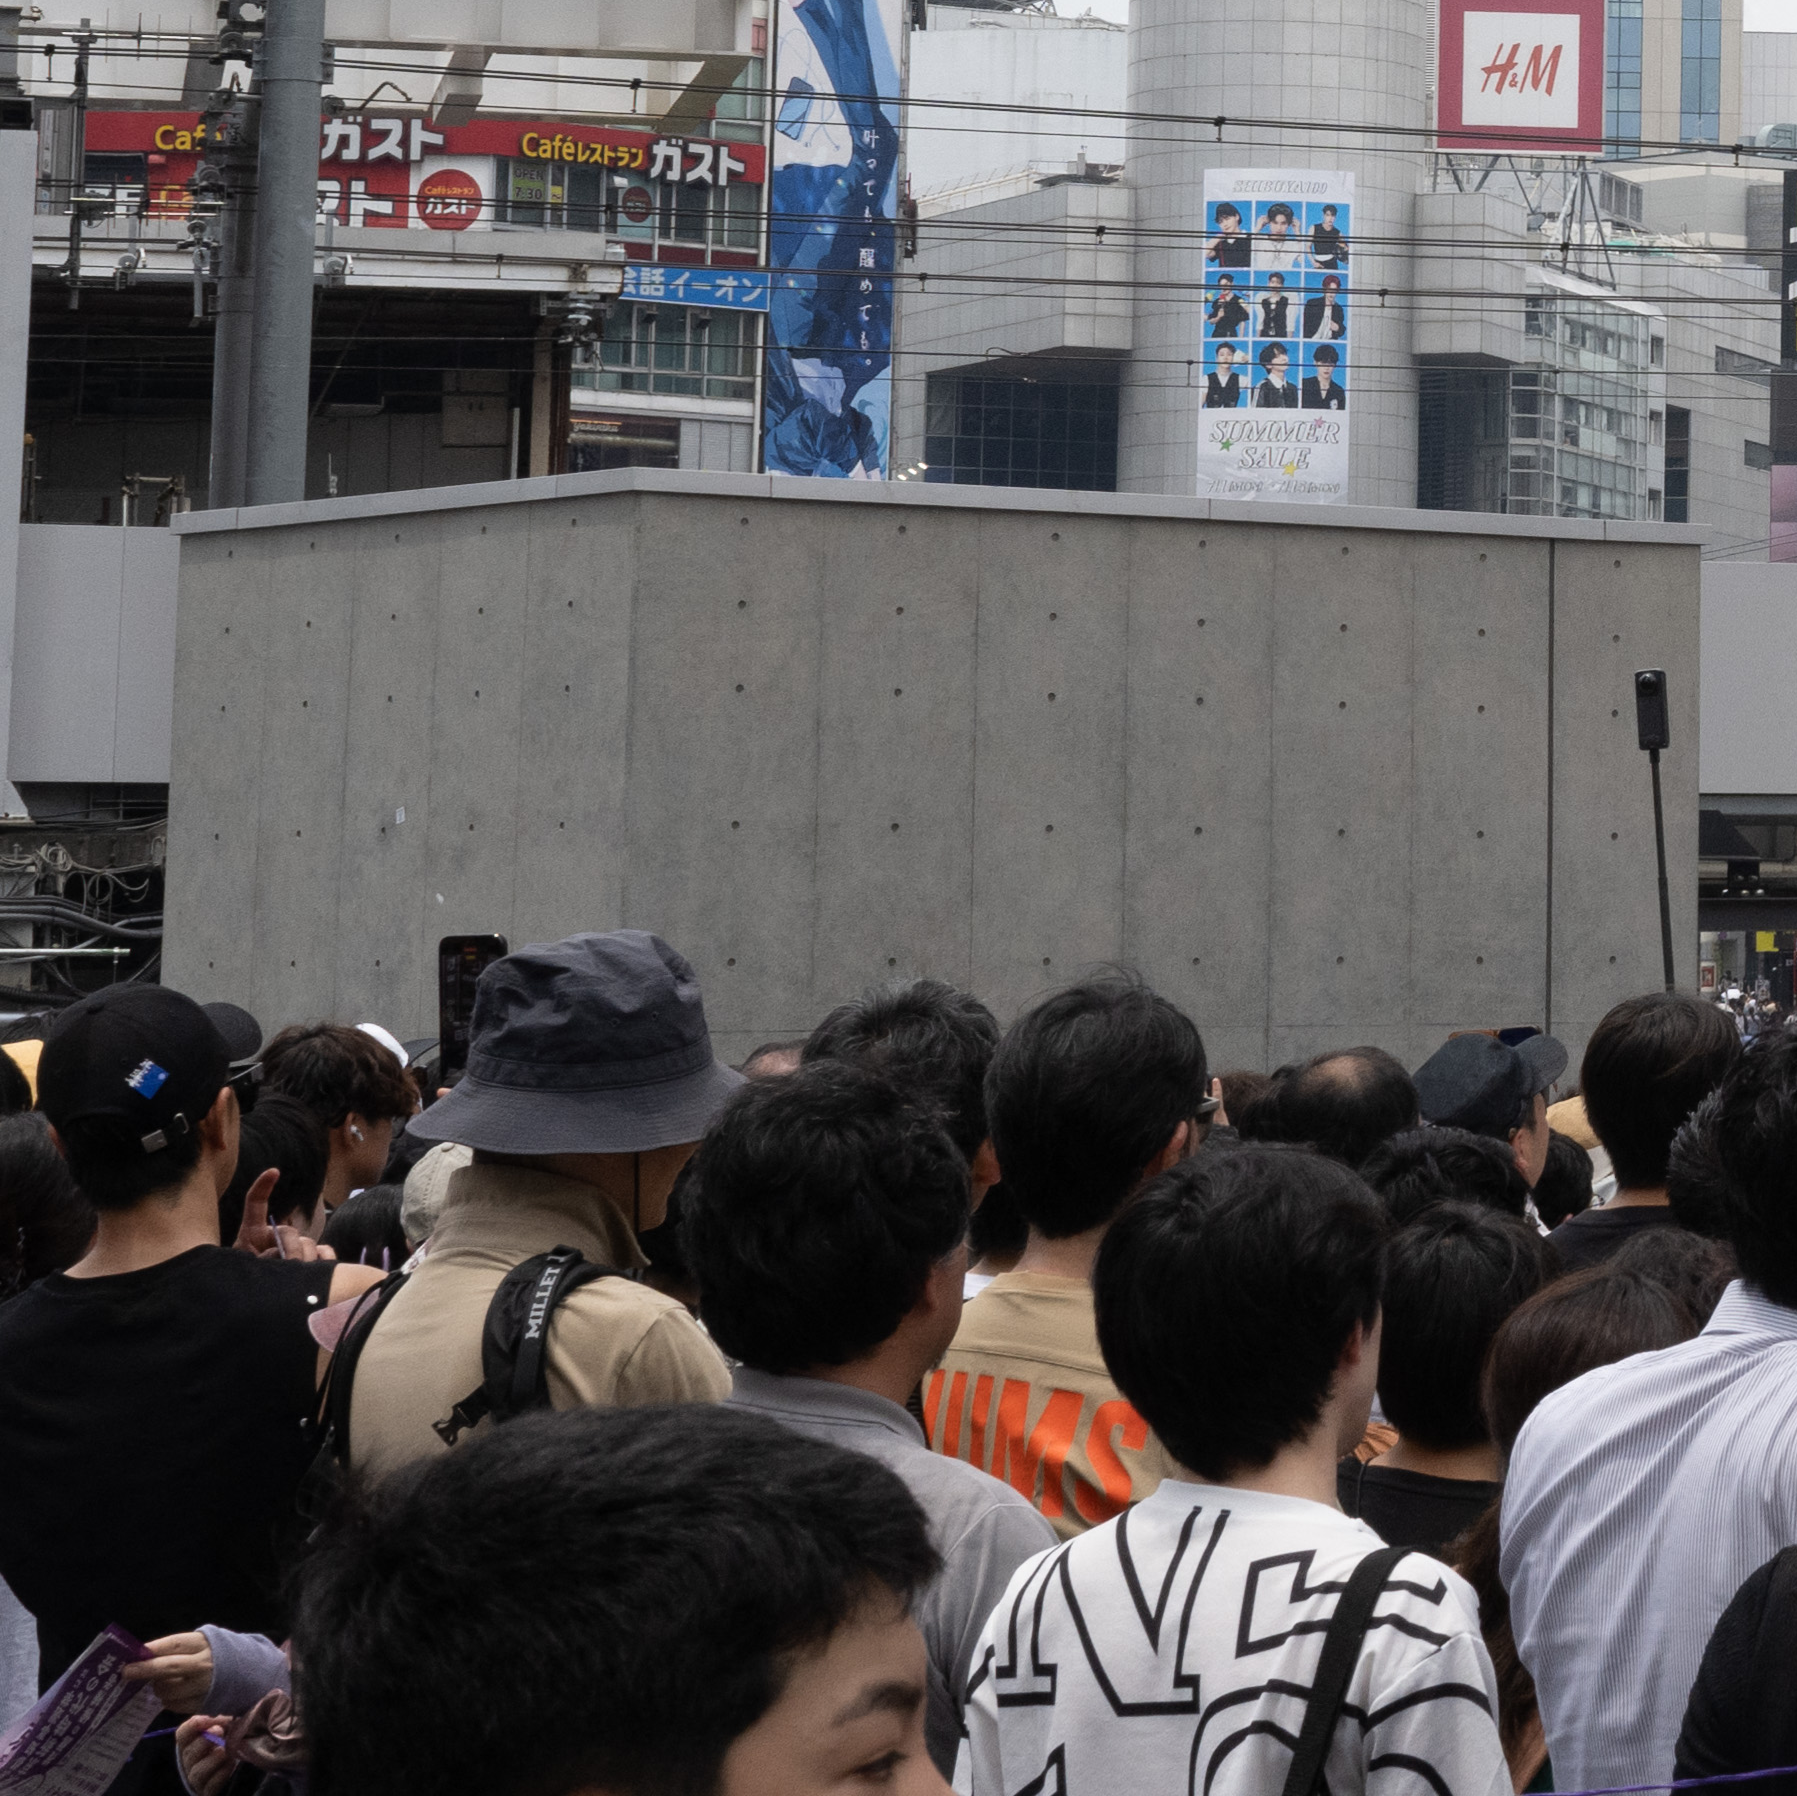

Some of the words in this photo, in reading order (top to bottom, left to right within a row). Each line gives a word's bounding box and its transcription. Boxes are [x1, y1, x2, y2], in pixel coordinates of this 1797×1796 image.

[1480, 42, 1564, 97] H&M
[321, 116, 444, 161] ガスト
[651, 139, 746, 186] ガスト
[1208, 420, 1341, 444] SUMMER
[1238, 446, 1312, 470] SALE
[524, 1266, 561, 1340] MILLET
